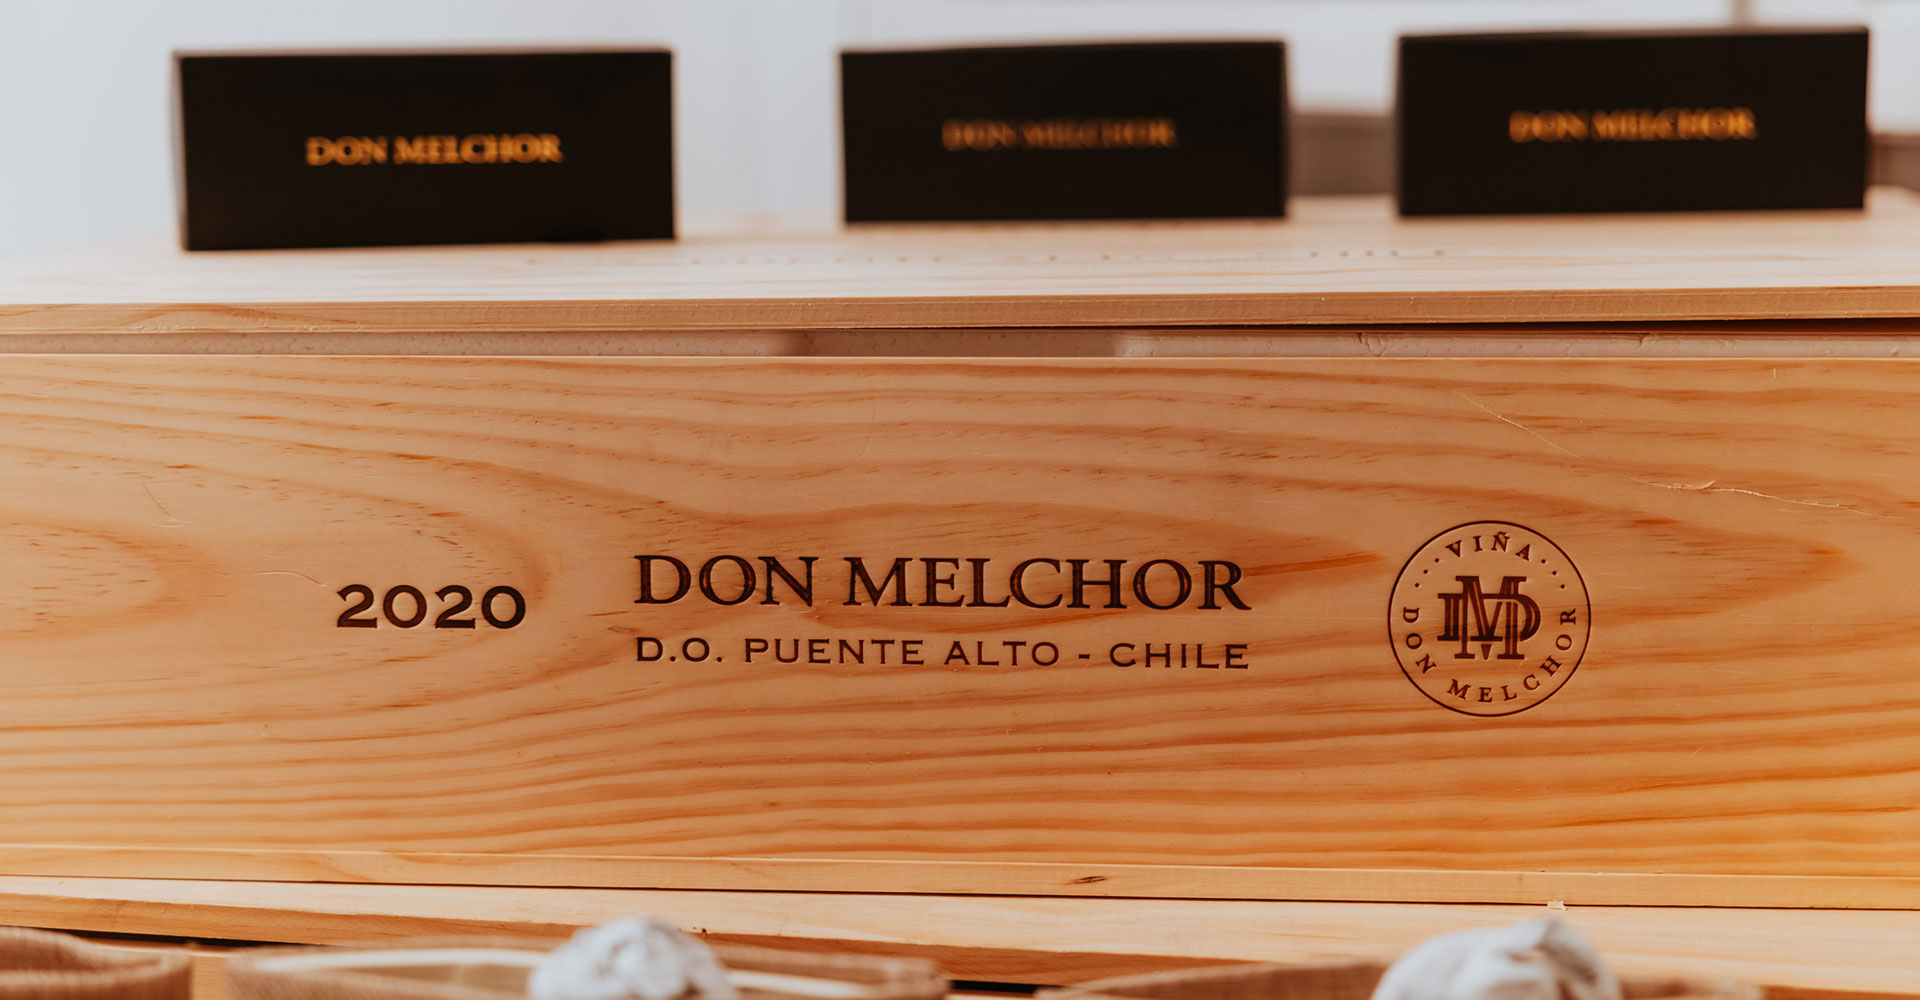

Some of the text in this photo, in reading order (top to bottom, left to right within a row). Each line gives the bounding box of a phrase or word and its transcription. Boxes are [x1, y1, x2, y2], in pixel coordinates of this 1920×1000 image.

[1509, 110, 1587, 142] DON
[306, 133, 563, 166] DON MELCHOR
[1445, 531, 1531, 562] VIÑA
[634, 554, 1253, 611] DON MELCHOR
[336, 583, 527, 630] 2020
[636, 637, 723, 663] D.O.
[744, 638, 925, 666] PUENTE
[944, 640, 1060, 667] ALTO
[1109, 642, 1249, 669] CHILE
[1403, 606, 1577, 703] DON MELCHOR
